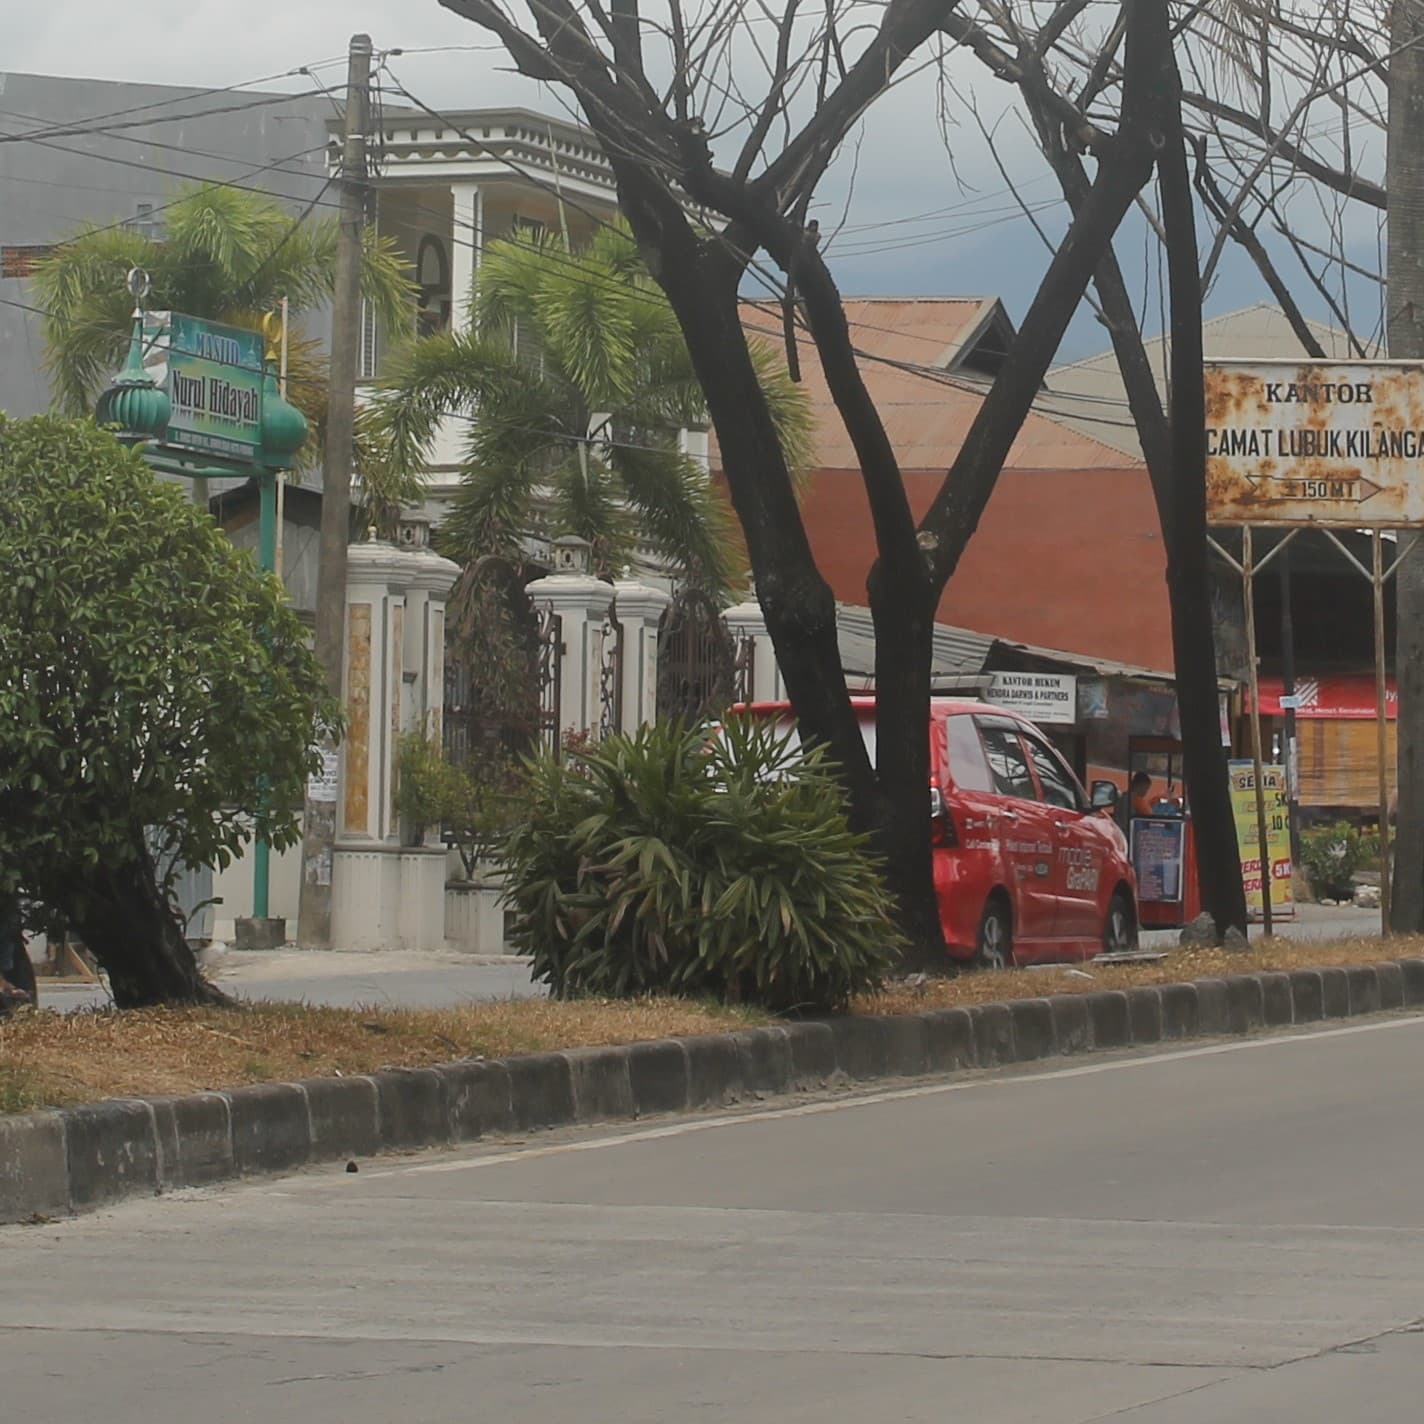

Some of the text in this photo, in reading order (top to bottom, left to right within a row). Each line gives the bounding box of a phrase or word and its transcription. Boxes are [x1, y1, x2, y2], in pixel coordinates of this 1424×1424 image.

[196, 331, 240, 364] MASJID
[172, 369, 259, 424] Nurul Hidayah
[1266, 382, 1373, 404] KANTOR
[1206, 429, 1273, 456] CAMAT
[1278, 429, 1344, 458] LUBUK
[1302, 481, 1326, 497] 150
[1239, 776, 1276, 789] SEIA
